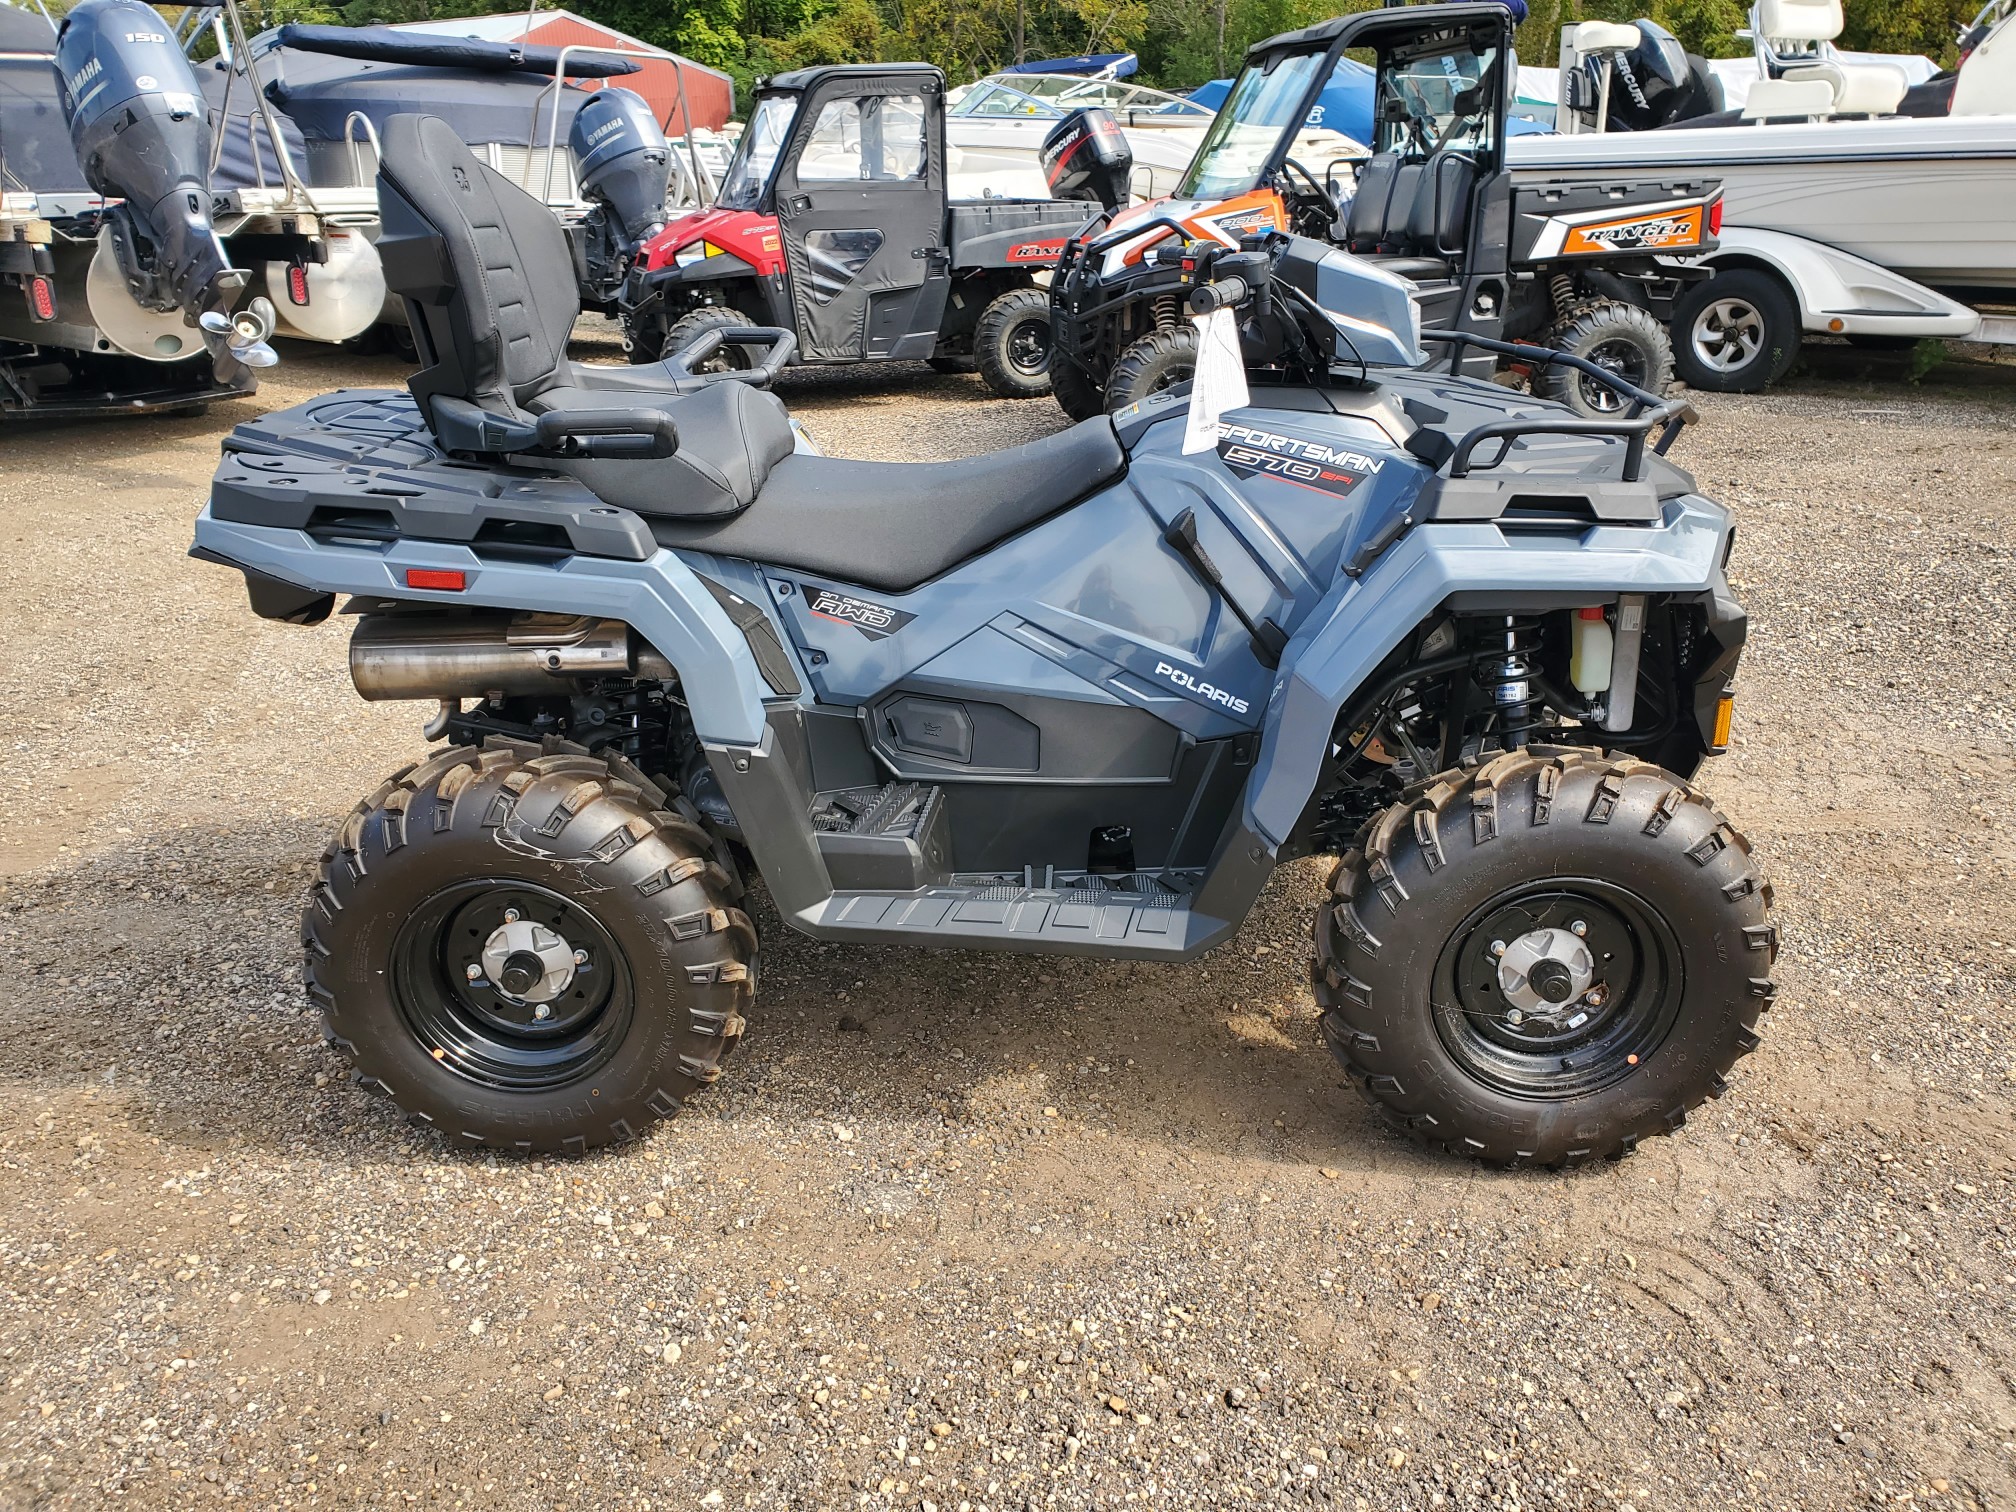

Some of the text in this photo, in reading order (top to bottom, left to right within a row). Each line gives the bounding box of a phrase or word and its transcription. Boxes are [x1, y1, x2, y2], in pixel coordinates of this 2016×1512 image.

[125, 32, 166, 43] 150
[69, 57, 104, 97] YAMAHA
[593, 117, 625, 141] YAMAHA
[1044, 127, 1081, 169] MERCURY
[1583, 222, 1693, 243] RANGER
[1218, 421, 1386, 475] SPORTSMAN
[1223, 445, 1353, 486] 570 EFI
[812, 597, 892, 628] AWD
[820, 590, 896, 616] ON DEMAND
[1154, 661, 1250, 714] POLARIS
